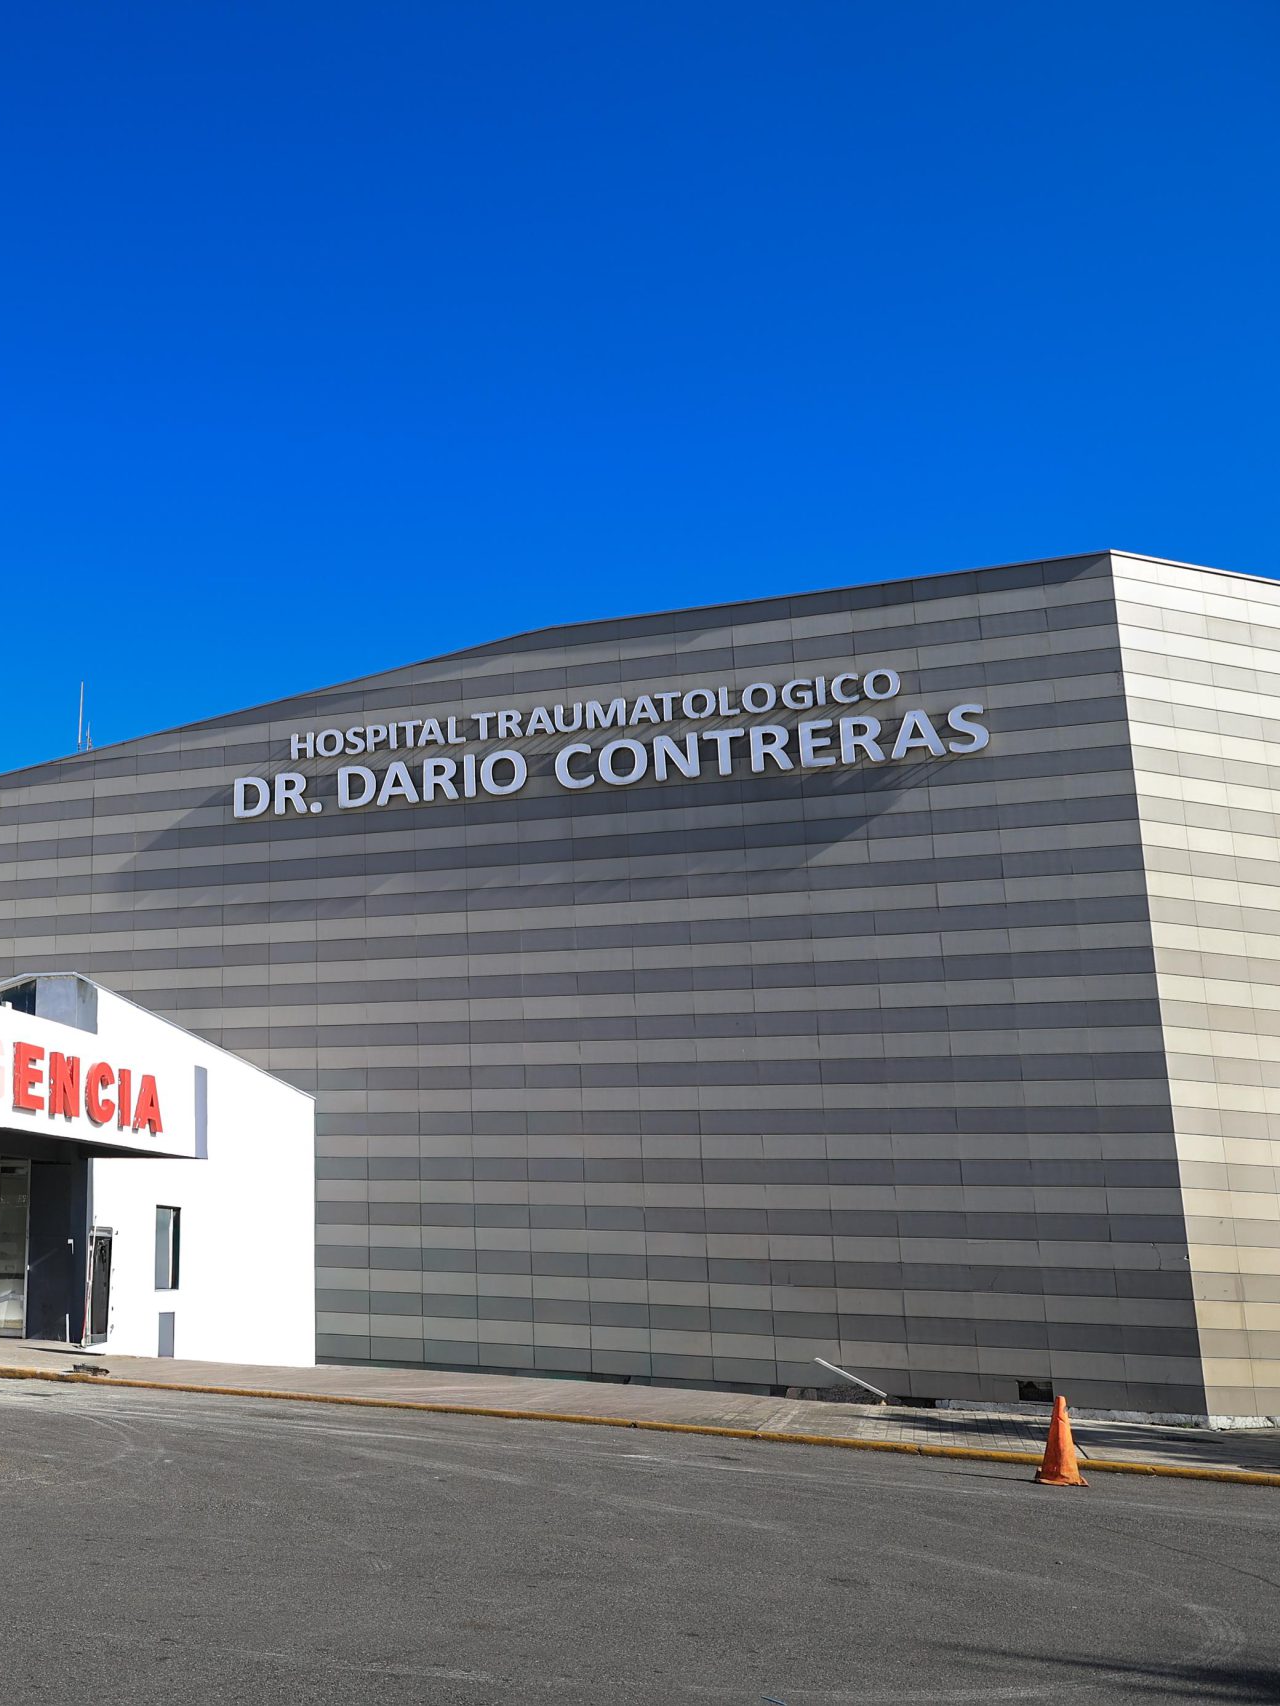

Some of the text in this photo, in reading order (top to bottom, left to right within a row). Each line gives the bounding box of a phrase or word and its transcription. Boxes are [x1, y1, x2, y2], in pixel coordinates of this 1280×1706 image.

[233, 703, 990, 818] DR. DARIO CONTRERAS
[290, 667, 901, 760] HOSPITAL TRAUMATOLOGICO
